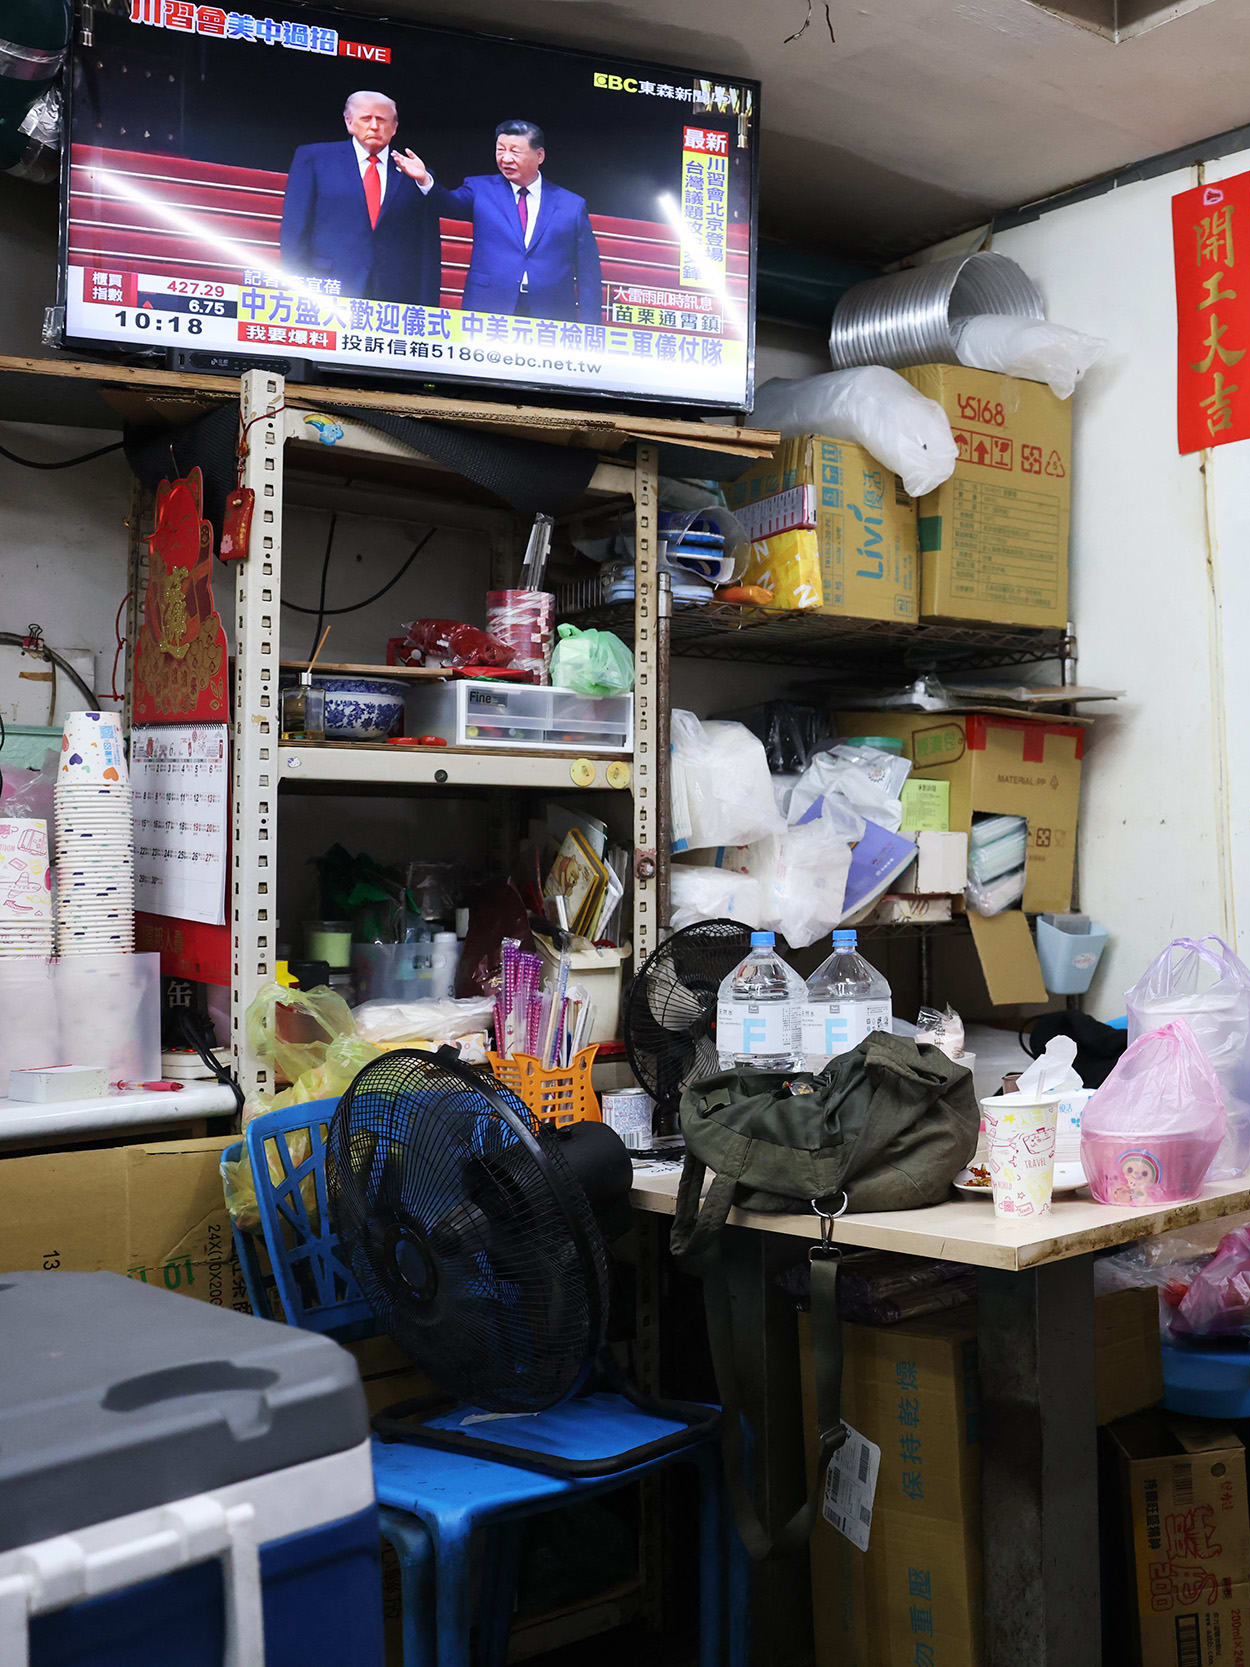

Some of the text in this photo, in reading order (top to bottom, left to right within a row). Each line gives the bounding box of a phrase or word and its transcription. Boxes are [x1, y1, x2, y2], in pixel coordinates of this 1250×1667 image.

[346, 43, 387, 62] LIVE
[684, 128, 728, 154] 最新
[705, 156, 726, 263] 川習會北京登場
[91, 271, 124, 289] 櫃買
[166, 281, 225, 299] 427.29
[91, 286, 124, 303] 指數
[188, 299, 226, 315] 6.75
[114, 310, 204, 335] 10:18
[240, 287, 452, 340] 中方盛大歡迎儀式
[614, 303, 720, 333] 苗栗通霄鎮
[1189, 204, 1246, 438] 開工大吉
[246, 324, 328, 347] 我要爆料
[342, 333, 602, 374] 投訴信箱5186@ebc.net.tw
[847, 504, 884, 580] Livi
[469, 691, 492, 703] Fine
[743, 1018, 767, 1054] F
[825, 1018, 848, 1055] F
[1025, 1157, 1048, 1169] TRAVEL
[896, 1360, 925, 1500] 保持乾燥
